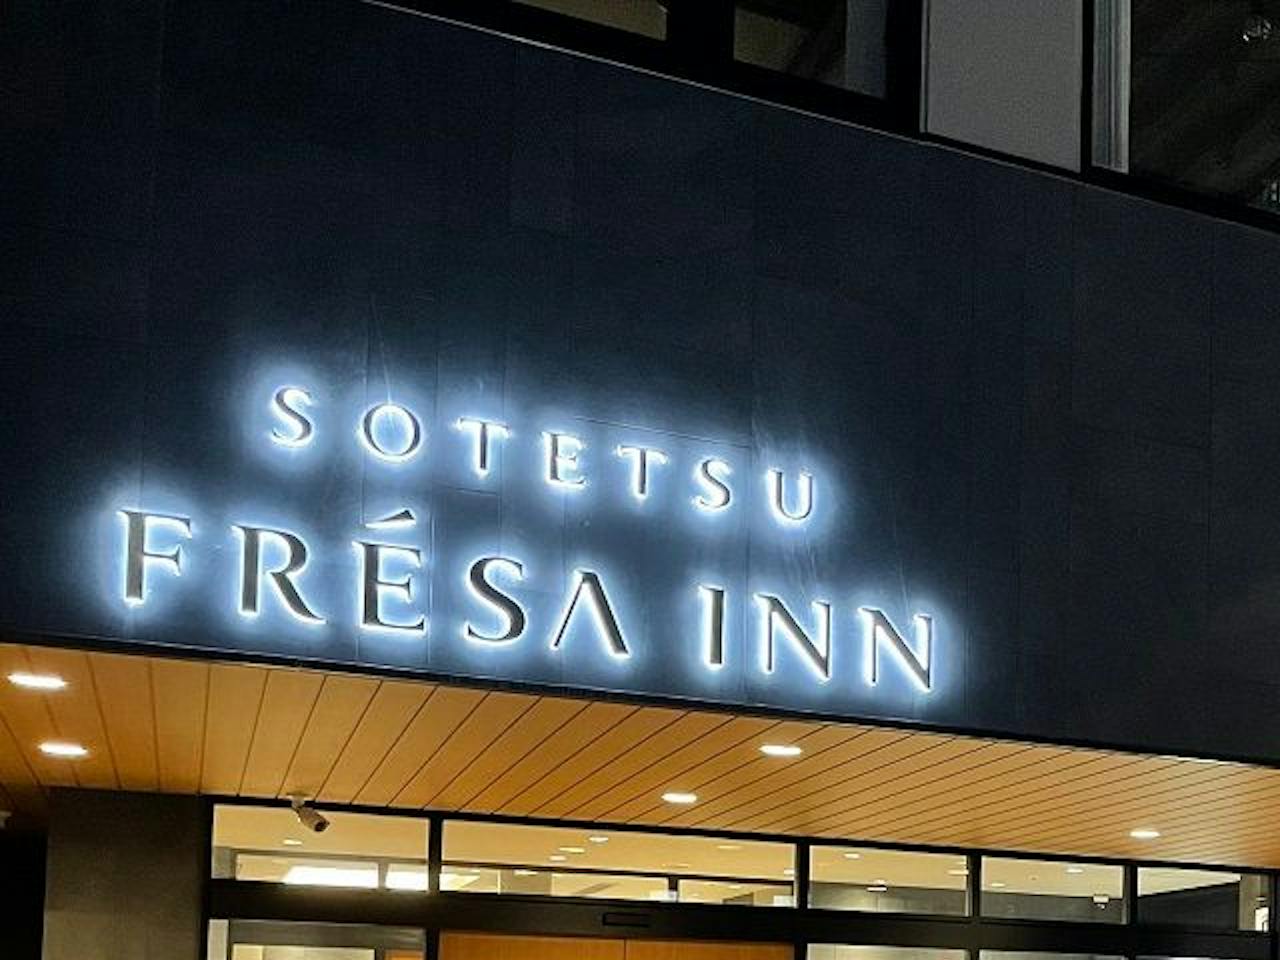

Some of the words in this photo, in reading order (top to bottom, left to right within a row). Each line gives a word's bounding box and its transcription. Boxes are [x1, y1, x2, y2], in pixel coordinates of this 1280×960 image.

[269, 384, 817, 524] SOTETSU
[115, 505, 631, 662] FRÉSA
[694, 582, 937, 695] INN
